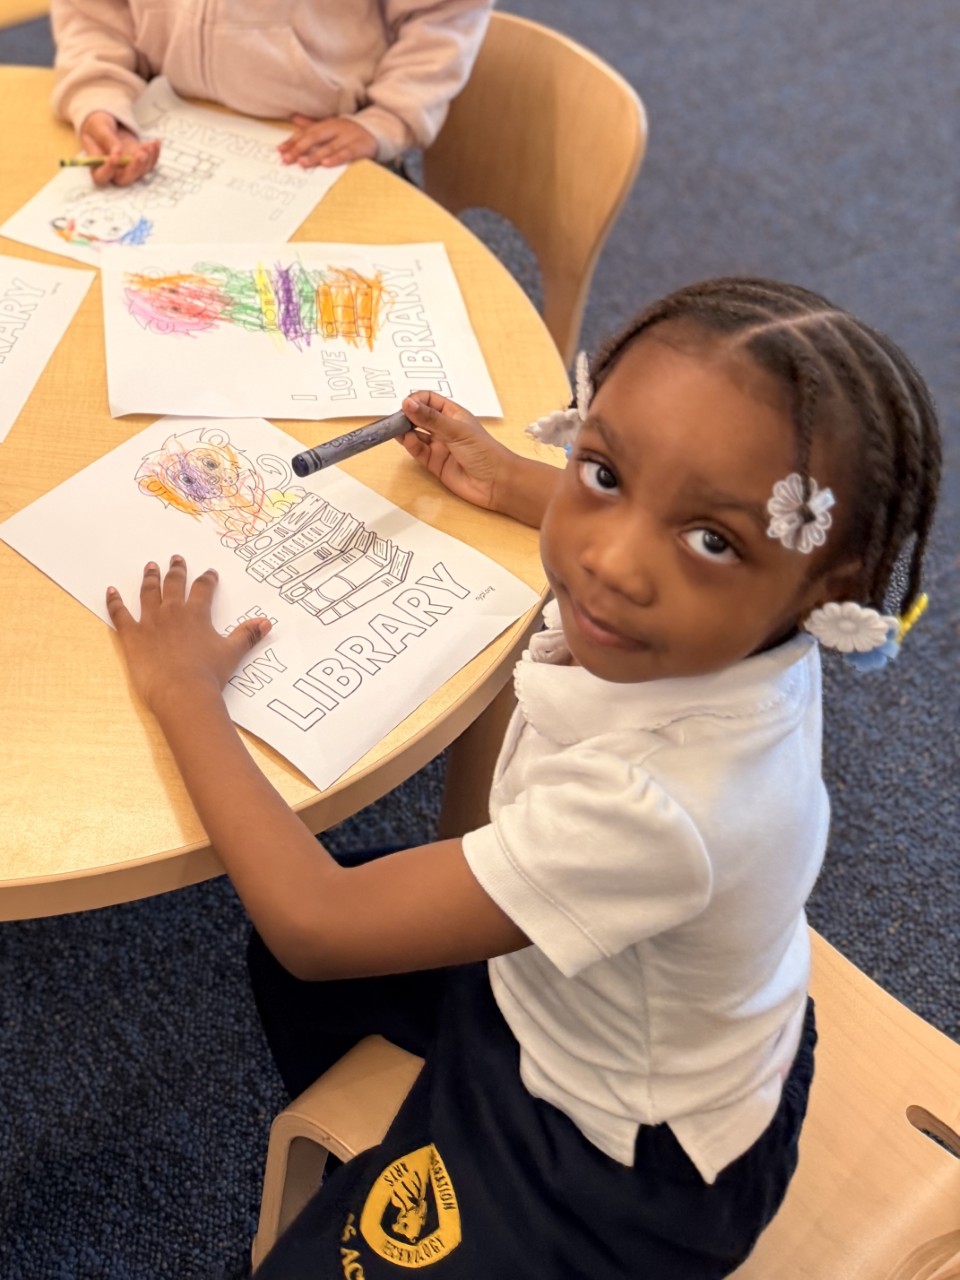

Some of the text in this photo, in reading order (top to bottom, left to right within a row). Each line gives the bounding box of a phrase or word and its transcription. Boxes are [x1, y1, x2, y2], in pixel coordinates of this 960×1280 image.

[372, 262, 453, 399] LIBRARY
[321, 349, 357, 402] LOVE
[362, 366, 396, 399] MY
[228, 648, 287, 698] MY
[267, 562, 471, 732] LIBRARY
